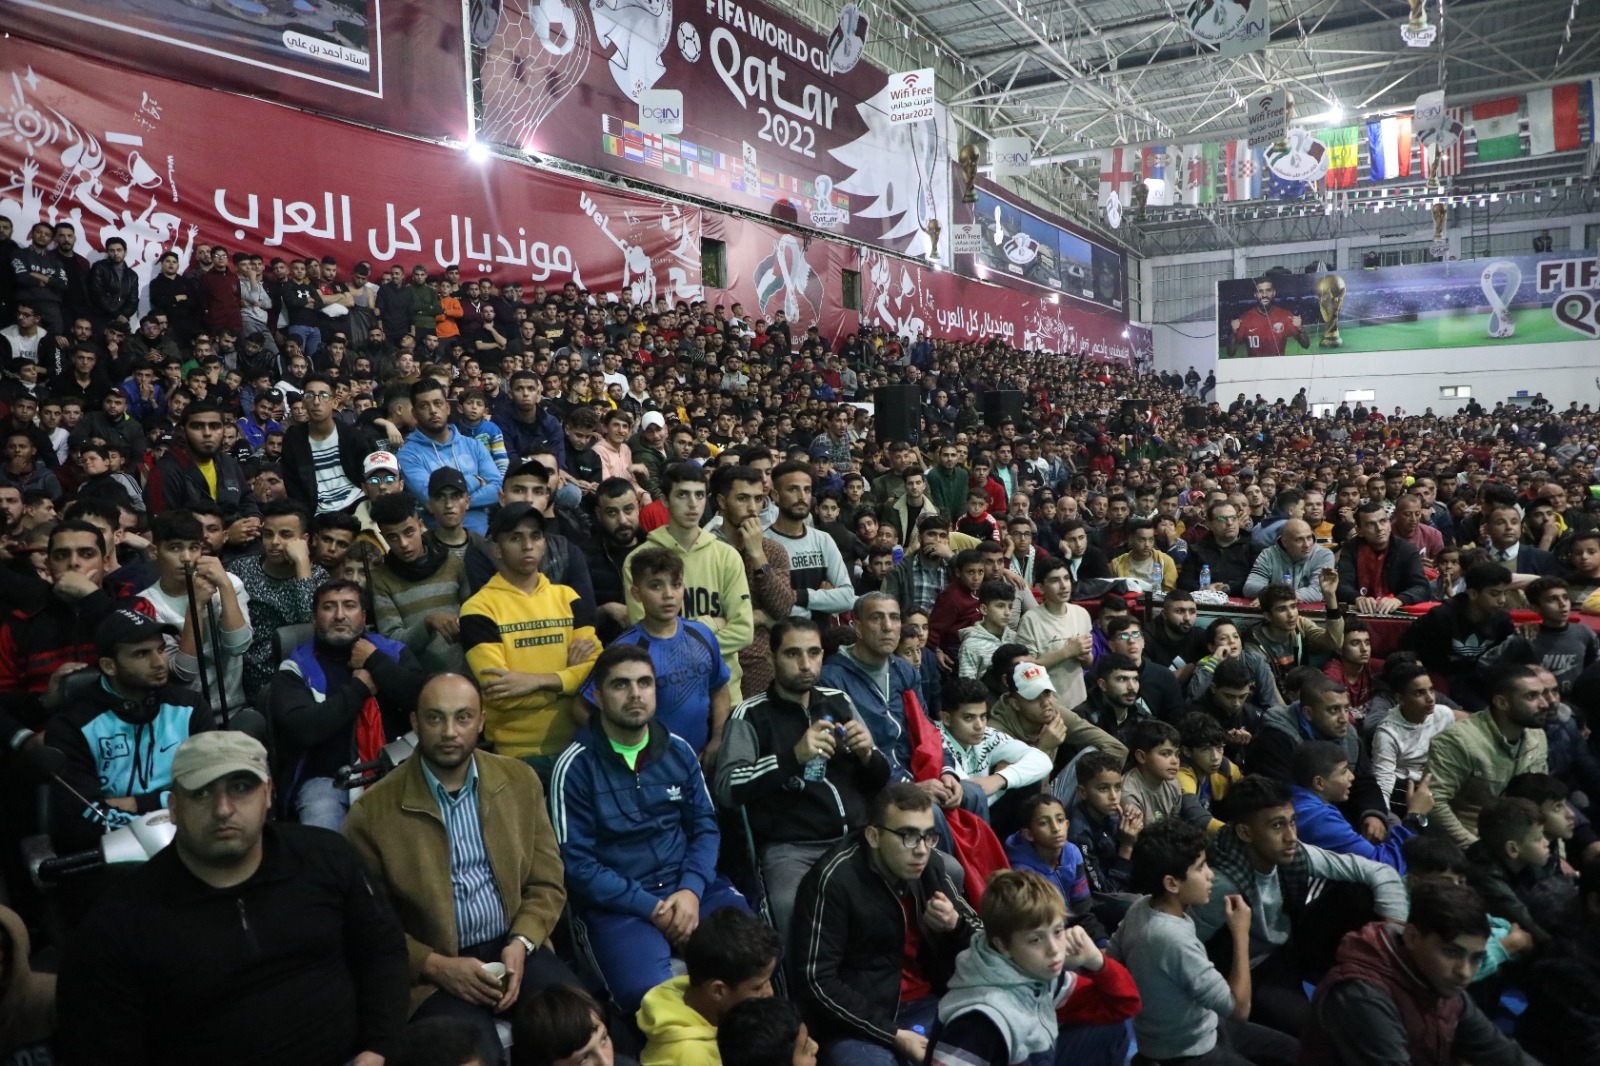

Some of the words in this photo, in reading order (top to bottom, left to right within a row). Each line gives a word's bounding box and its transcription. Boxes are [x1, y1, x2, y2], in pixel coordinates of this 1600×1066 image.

[286, 38, 308, 49] علي
[706, 0, 748, 32] FIFA
[748, 11, 808, 62] WORLD
[309, 44, 320, 55] بن
[322, 46, 342, 59] أحمد
[710, 27, 838, 130] Qatar
[890, 88, 909, 100] Wifi
[912, 87, 933, 97] Free
[890, 108, 933, 122] Qatar2022
[1248, 111, 1265, 126] Wifi
[1266, 107, 1284, 119] Free
[758, 107, 816, 158] 2022
[1248, 128, 1285, 146] Qatar2022
[214, 188, 352, 246] العرب
[368, 203, 422, 261] كل
[434, 215, 573, 282] مونديال
[1541, 261, 1600, 290] FIF
[937, 306, 964, 333] العرب
[966, 309, 978, 336] كل
[980, 311, 1014, 341] مونديال
[1248, 336, 1259, 348] 10
[678, 587, 721, 618] NOS
[516, 635, 563, 647] CALIFORNIA
[1542, 654, 1577, 670] NIKE
